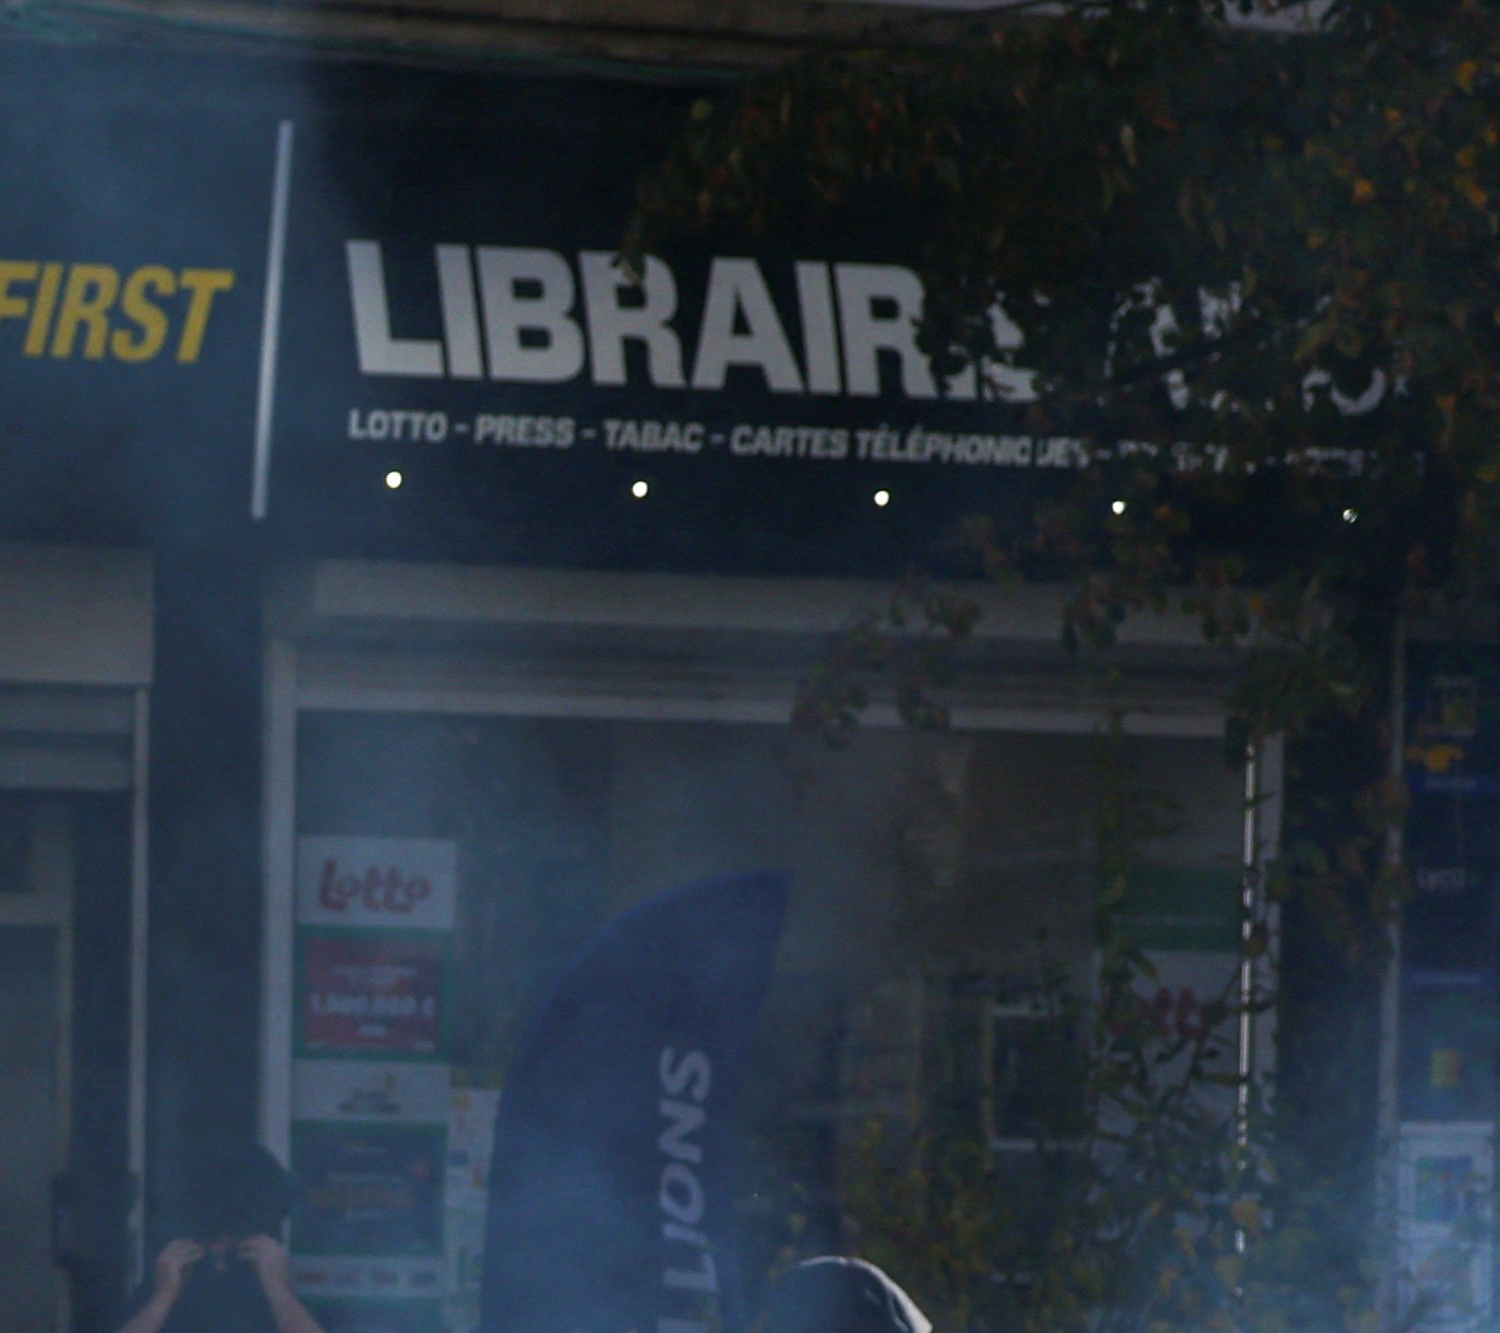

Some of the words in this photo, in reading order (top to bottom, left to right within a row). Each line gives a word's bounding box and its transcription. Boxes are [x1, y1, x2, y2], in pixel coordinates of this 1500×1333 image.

[347, 409, 449, 444] LOTTO
[473, 412, 577, 450] PRESS
[602, 418, 706, 455] TABAC
[728, 422, 851, 461] CARTES
